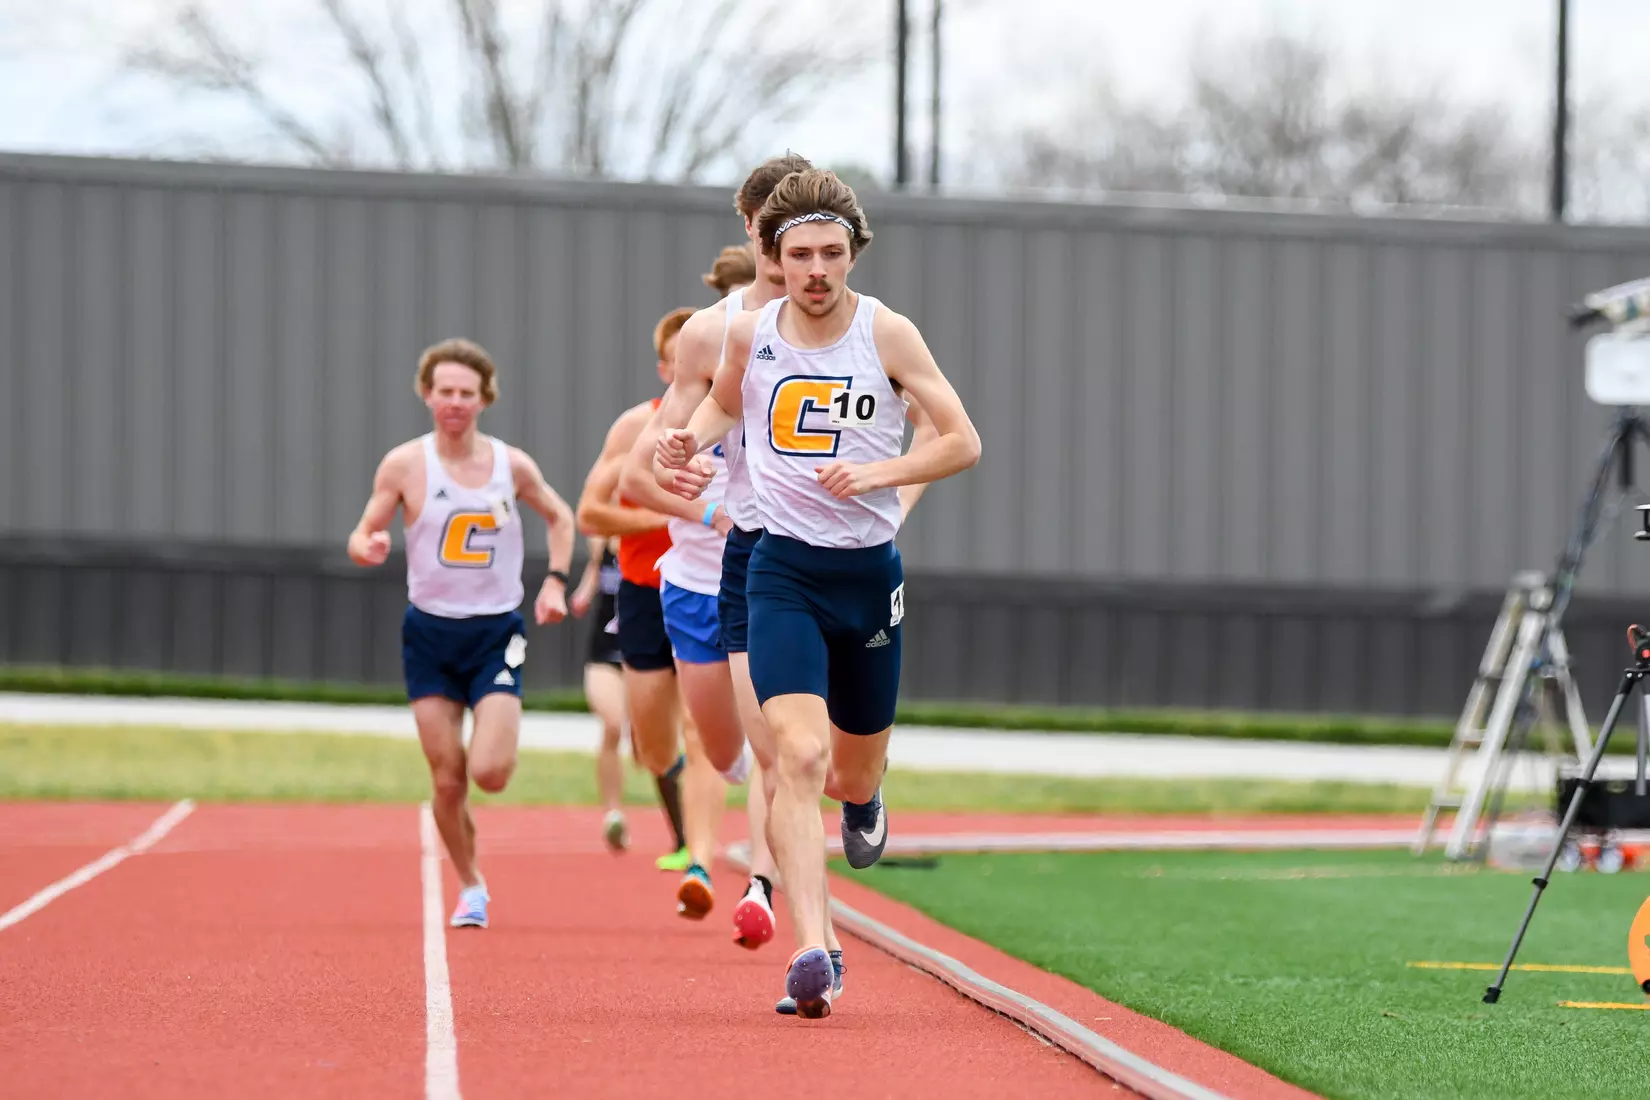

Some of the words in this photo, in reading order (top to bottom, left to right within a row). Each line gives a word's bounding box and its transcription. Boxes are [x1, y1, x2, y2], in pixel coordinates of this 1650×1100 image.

[768, 375, 853, 457] C
[834, 392, 875, 420] 10
[438, 508, 498, 569] C
[865, 638, 891, 648] adidas
